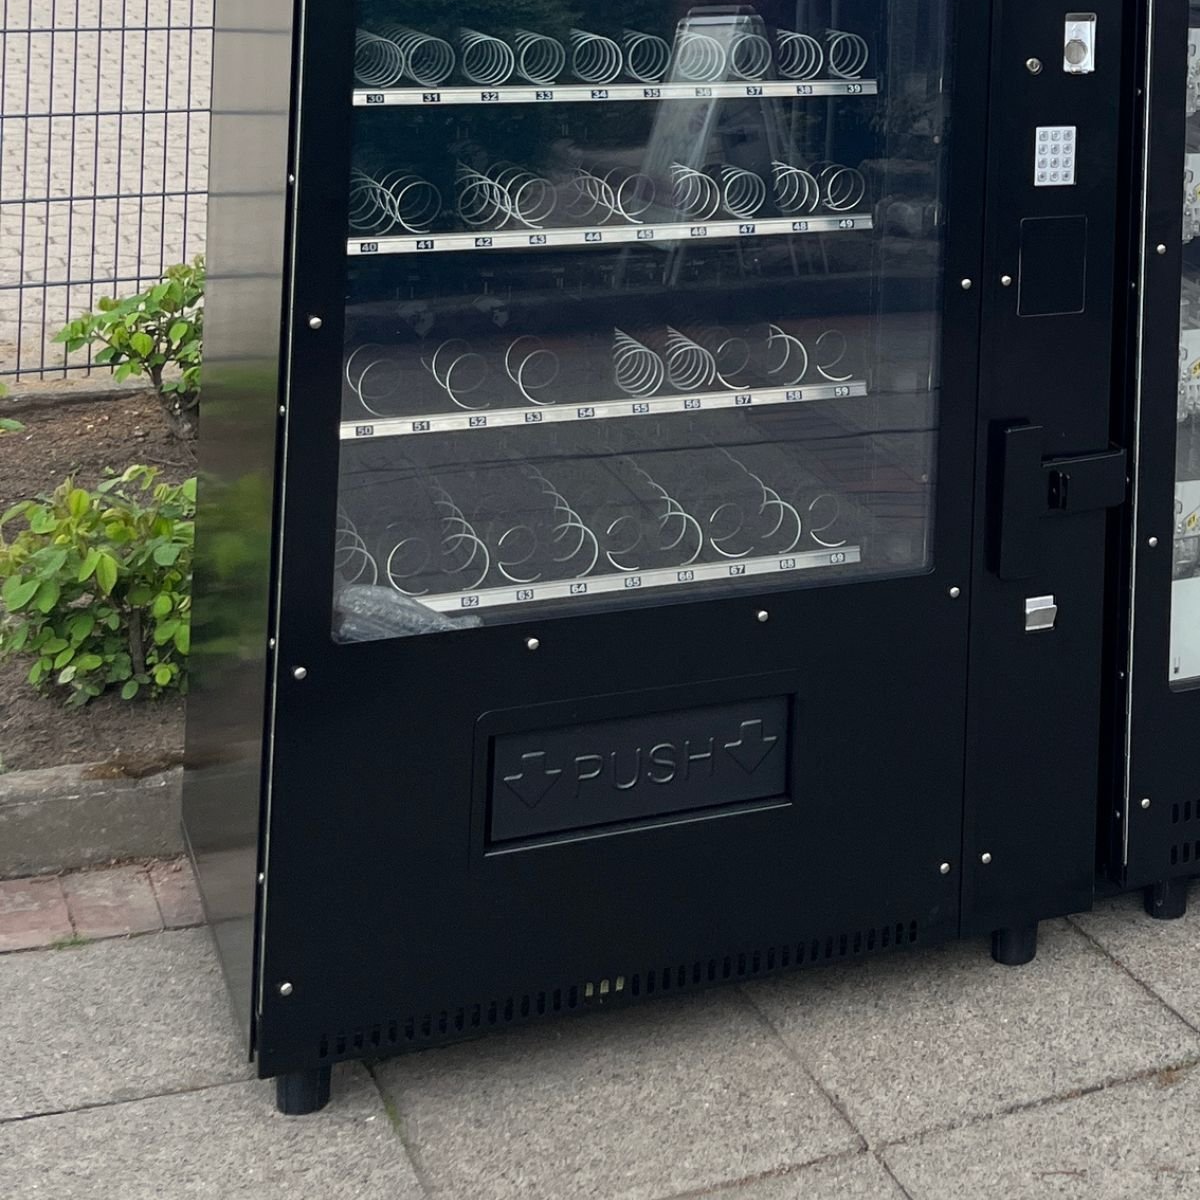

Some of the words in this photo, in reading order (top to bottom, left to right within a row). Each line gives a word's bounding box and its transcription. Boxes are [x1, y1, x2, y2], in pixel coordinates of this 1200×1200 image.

[368, 94, 382, 103] 30
[424, 93, 438, 102] 31
[483, 92, 497, 101] 32
[537, 90, 551, 100] 33
[592, 89, 606, 99] 34
[645, 88, 659, 98] 35
[747, 86, 761, 96] 37
[847, 84, 861, 94] 39
[362, 242, 376, 252] 40
[418, 240, 432, 249] 41
[476, 237, 490, 246] 42
[530, 235, 544, 244] 43
[586, 232, 600, 241] 44
[691, 227, 705, 236] 46
[739, 224, 753, 233] 47
[793, 221, 807, 231] 48
[840, 219, 854, 228] 49
[357, 426, 371, 435] 50
[414, 421, 428, 431] 51
[471, 416, 485, 426] 52
[526, 412, 540, 422] 53
[579, 408, 593, 418] 54
[634, 404, 648, 413] 55
[685, 399, 699, 409] 56
[736, 395, 750, 405] 57
[787, 391, 801, 400] 58
[835, 387, 849, 396] 59
[463, 597, 477, 606] 62
[518, 590, 532, 600] 63
[571, 584, 585, 593] 64
[626, 577, 640, 587] 65
[730, 565, 744, 575] 67
[780, 560, 794, 569] 68
[830, 554, 844, 563] 69
[575, 737, 714, 798] PUSH
